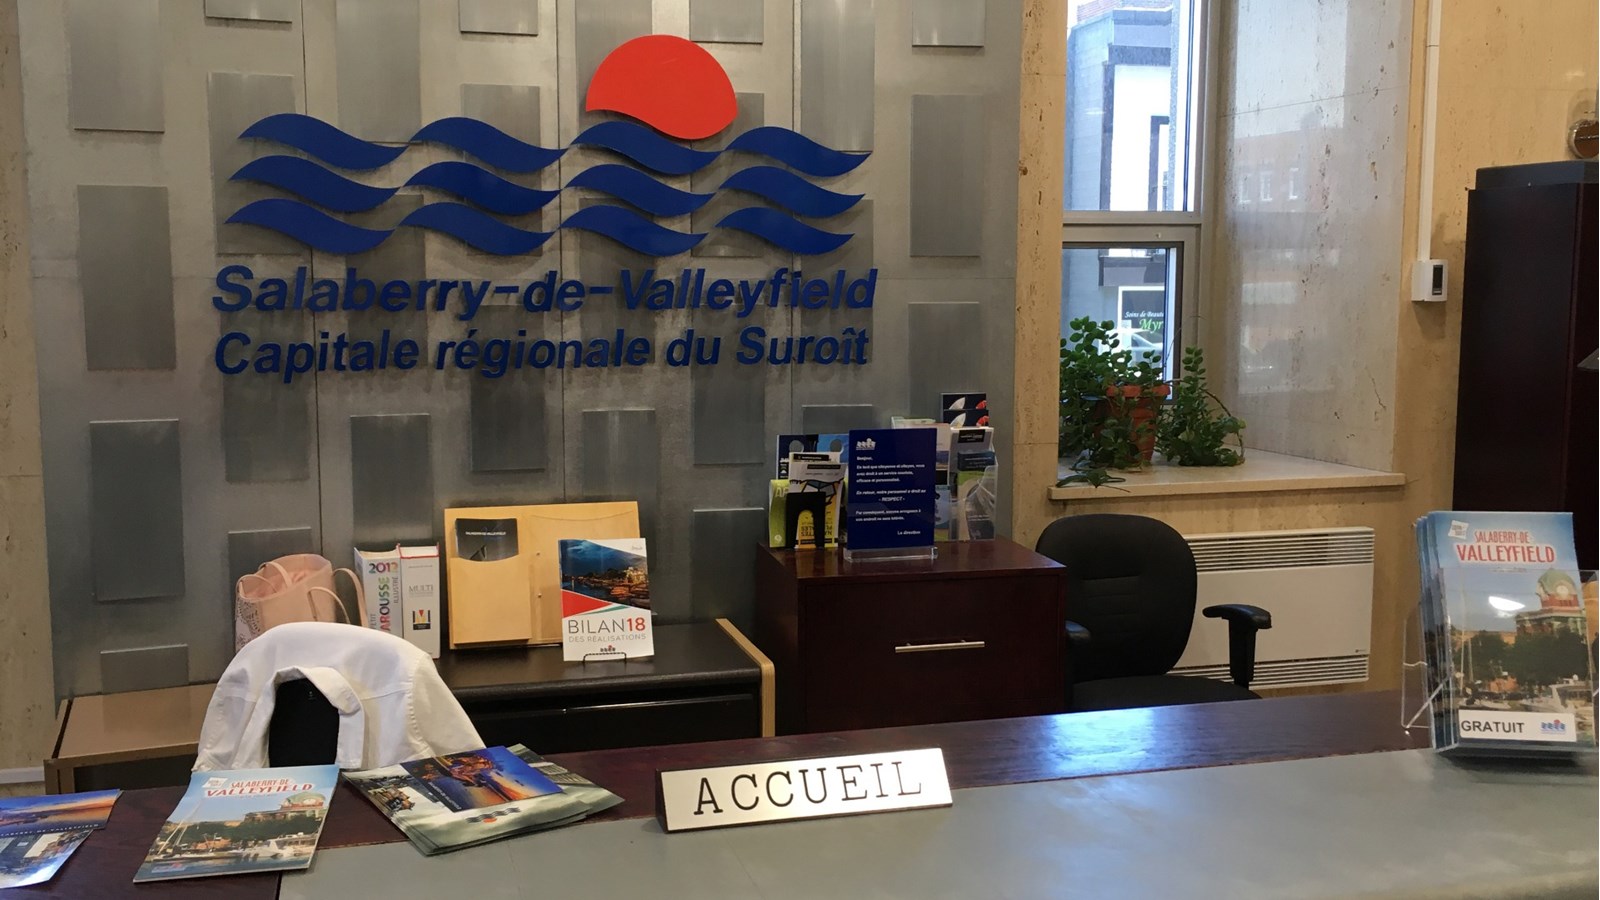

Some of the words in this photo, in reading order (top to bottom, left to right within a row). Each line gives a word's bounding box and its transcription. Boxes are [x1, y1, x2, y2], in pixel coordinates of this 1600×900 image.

[212, 265, 878, 321] Salaberry-de-Valleyfield
[215, 329, 419, 384] Capitale
[436, 328, 650, 379] régionale
[666, 329, 721, 367] du
[736, 326, 869, 365] Suroît
[1456, 544, 1555, 563] VALLEYFIELD
[378, 576, 391, 632] AROUSSE
[1461, 720, 1525, 733] GRATUIT
[693, 761, 922, 816] ACCUEIL
